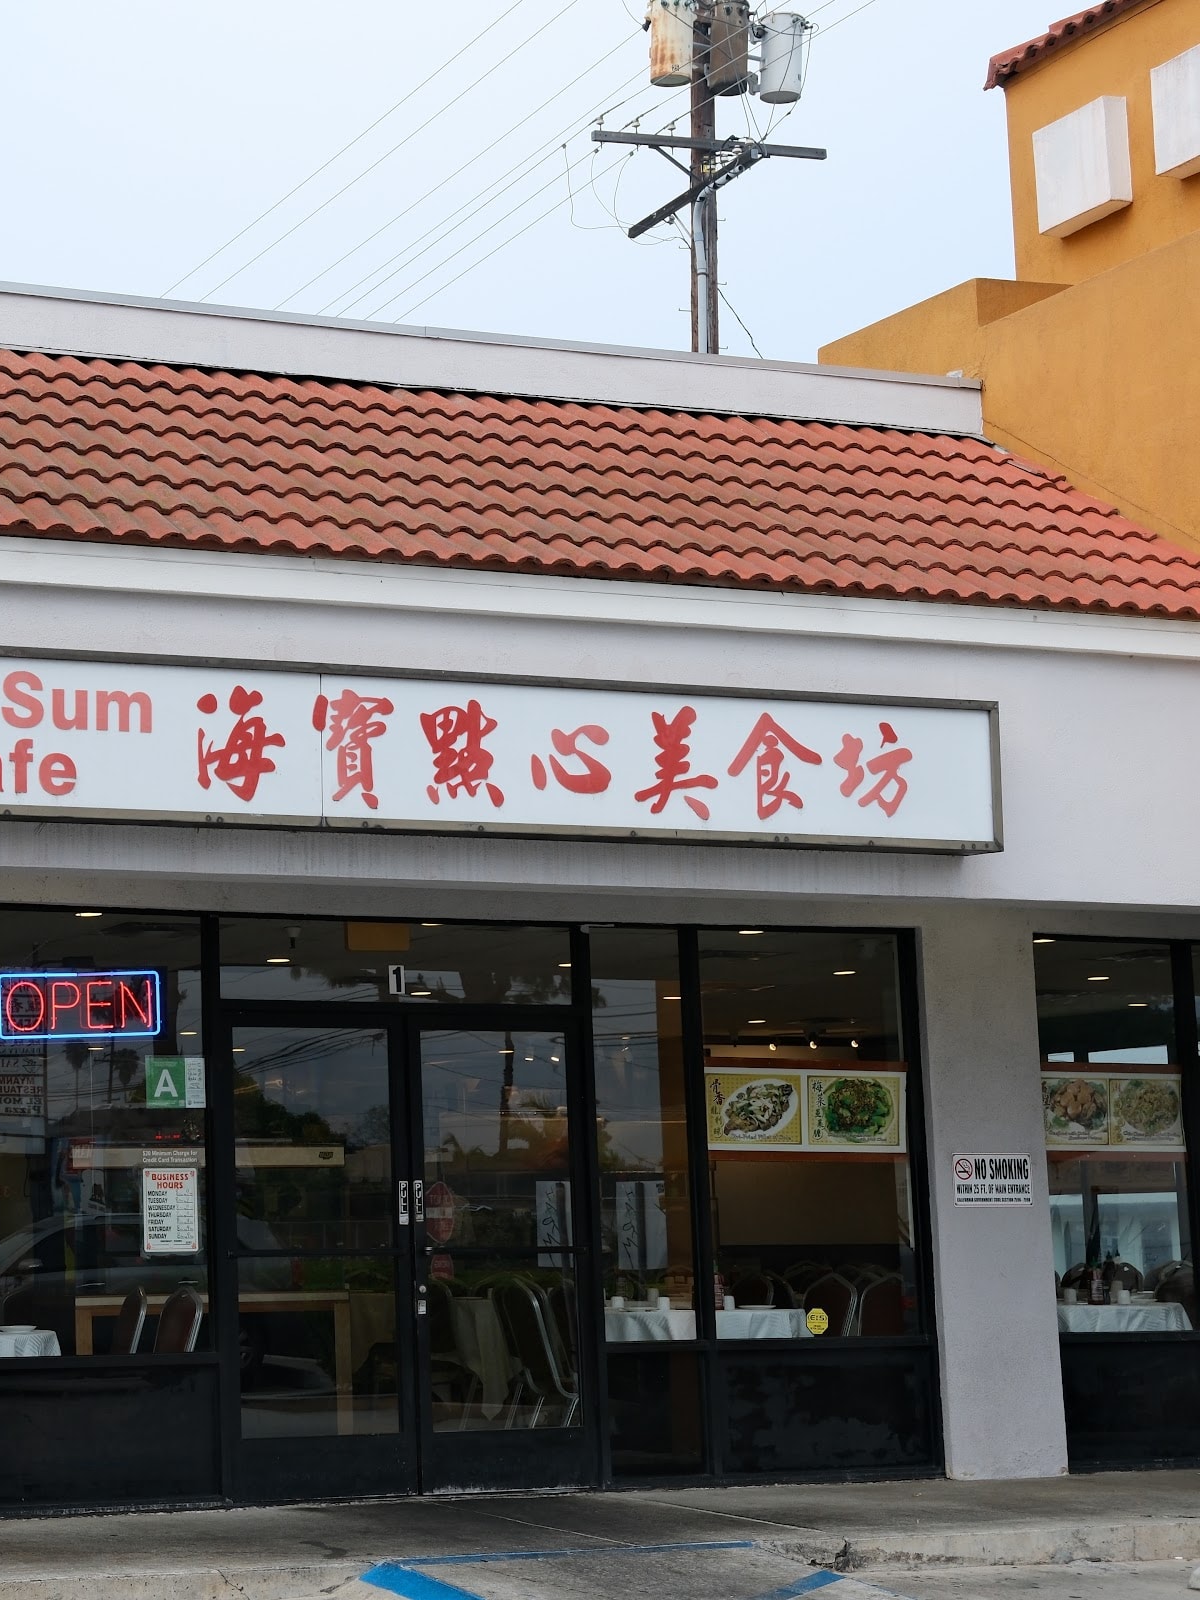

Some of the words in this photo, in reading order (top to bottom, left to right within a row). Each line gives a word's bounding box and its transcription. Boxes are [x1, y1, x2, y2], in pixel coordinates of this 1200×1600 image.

[1, 670, 153, 733] Sum
[196, 685, 913, 821] 海寶點心美食坊
[392, 966, 402, 992] 1
[5, 980, 152, 1031] OPEN
[154, 1069, 179, 1098] A
[151, 1173, 189, 1181] BUSINESS
[974, 1158, 987, 1180] NO
[989, 1158, 1029, 1180] SMOKING
[156, 1181, 184, 1189] HOURS
[956, 1184, 972, 1194] WITHIN
[973, 1184, 980, 1194] 25
[988, 1184, 994, 1194] OF
[995, 1184, 1007, 1194] MAIN
[1007, 1184, 1030, 1194] ENTRANCE
